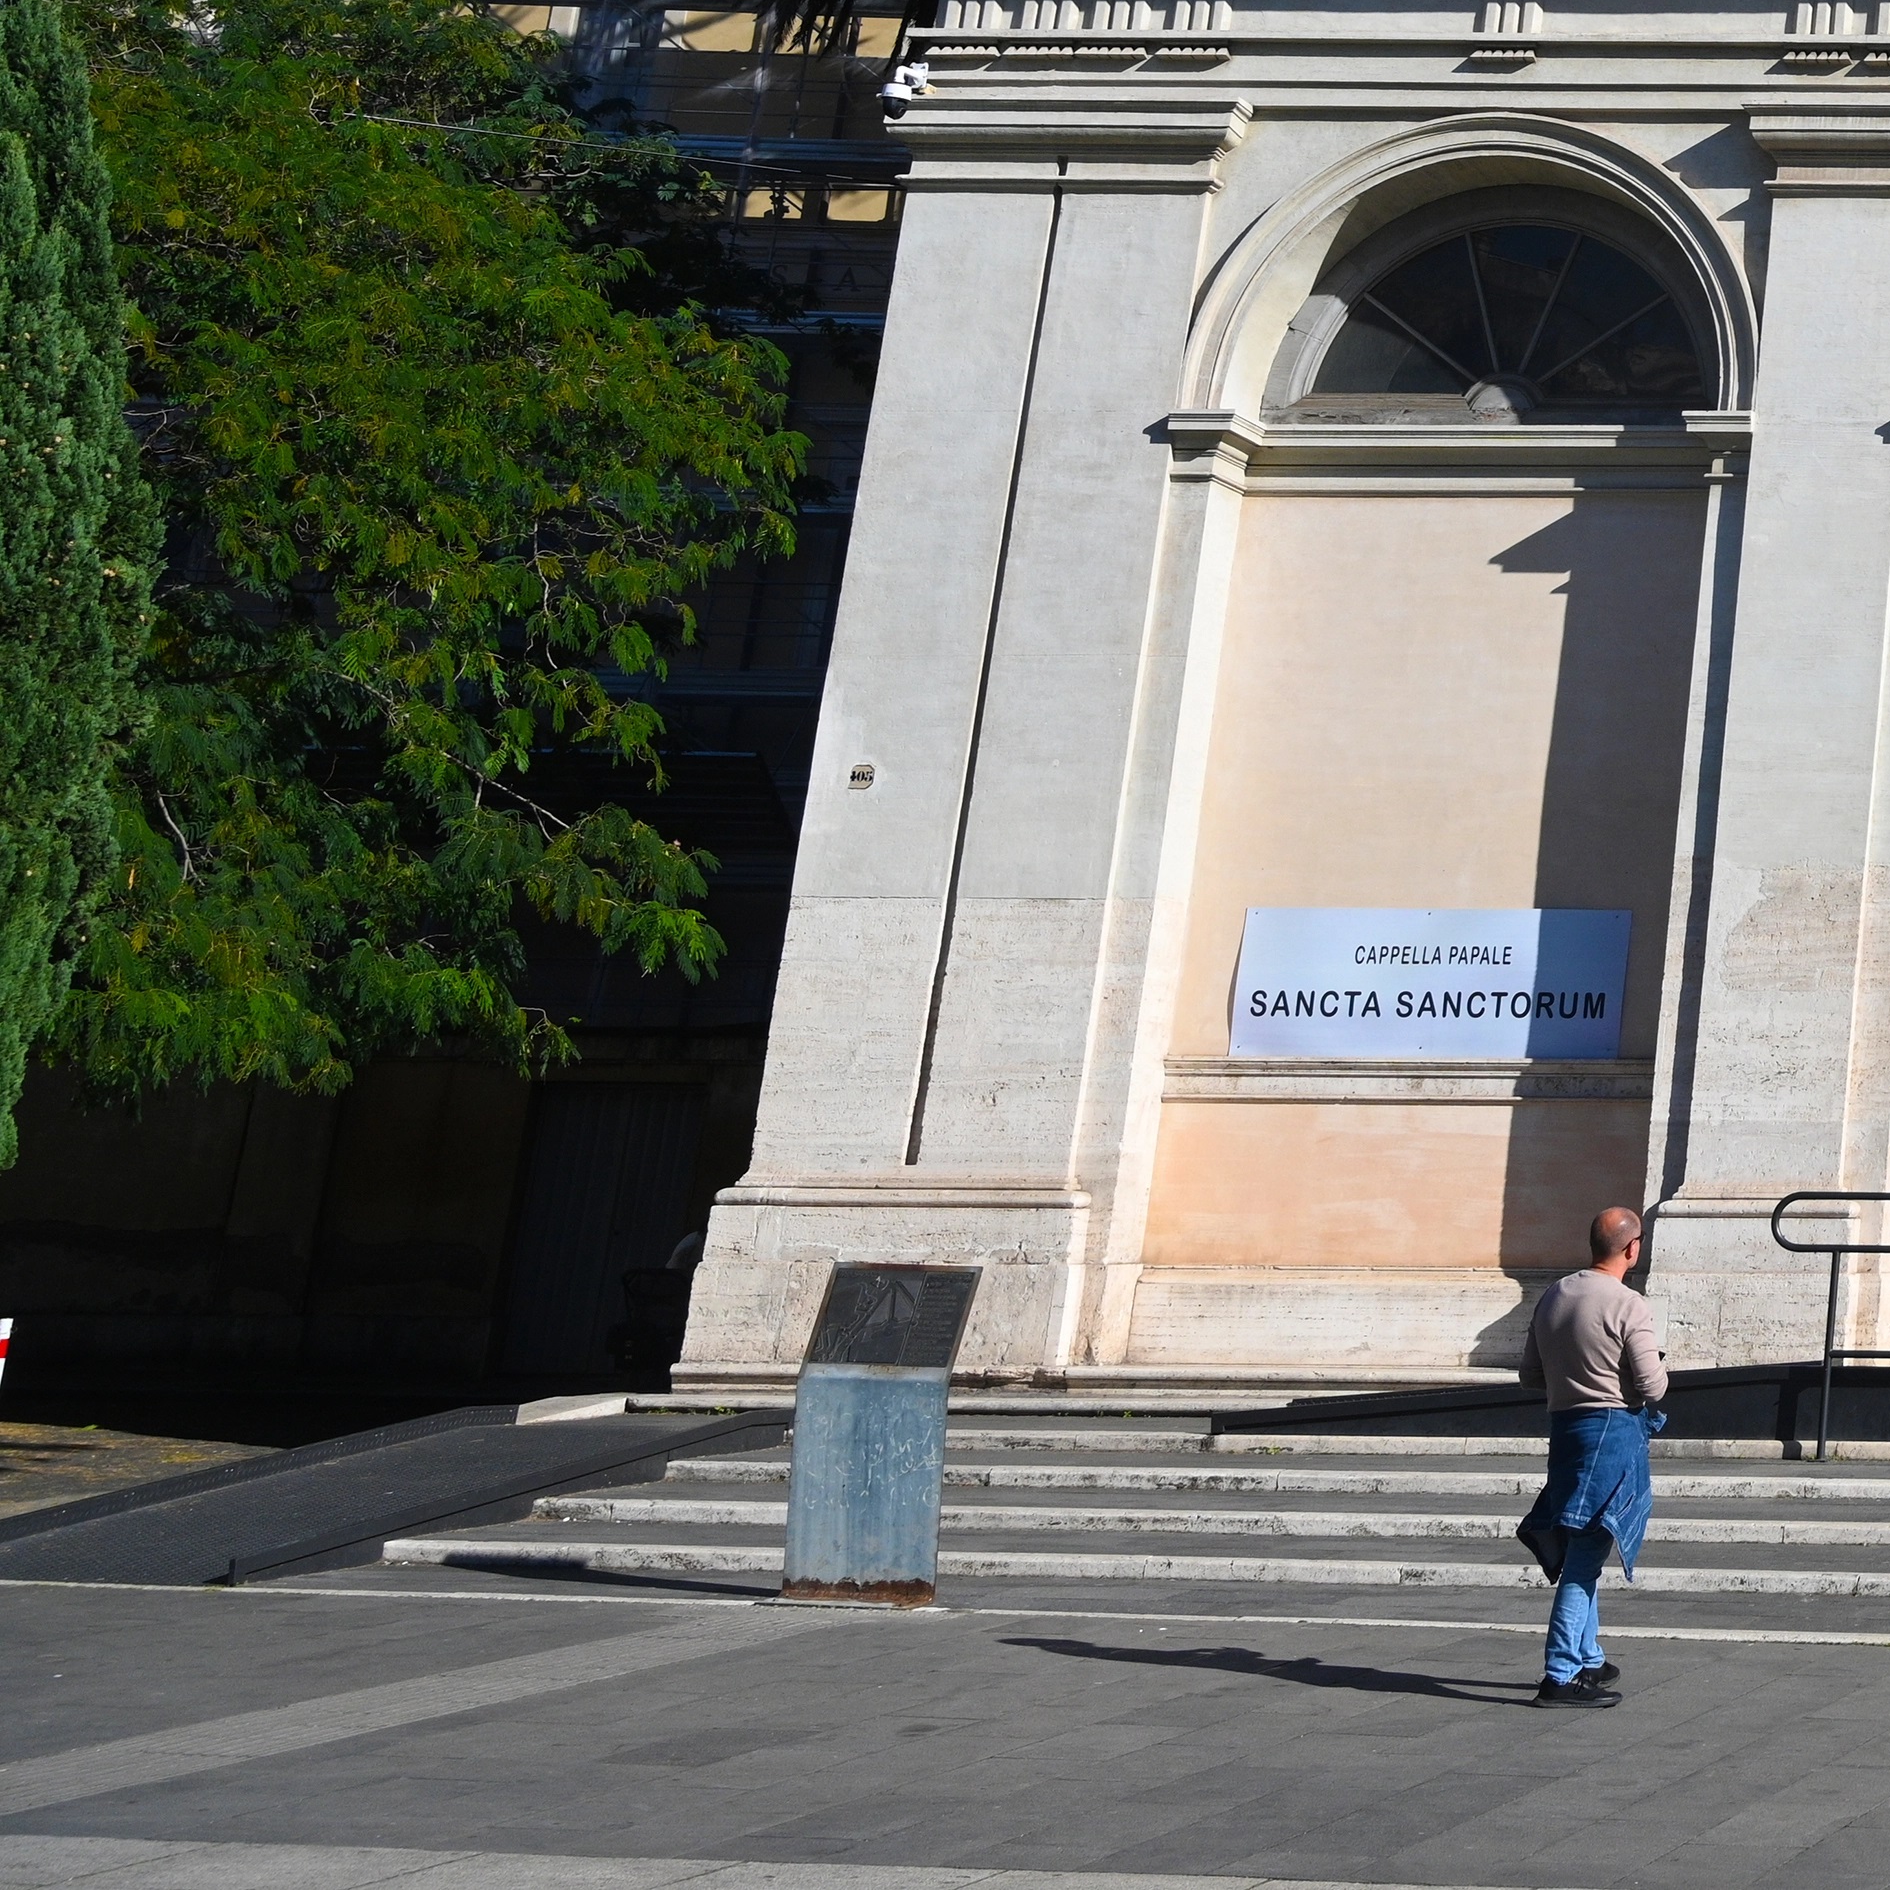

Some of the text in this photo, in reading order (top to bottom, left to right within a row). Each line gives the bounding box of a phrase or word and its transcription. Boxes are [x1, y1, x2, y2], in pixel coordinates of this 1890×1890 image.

[1354, 945, 1513, 965] CAPPELLA PAPALE
[1249, 989, 1606, 1019] SANCTA SANCTORUM
